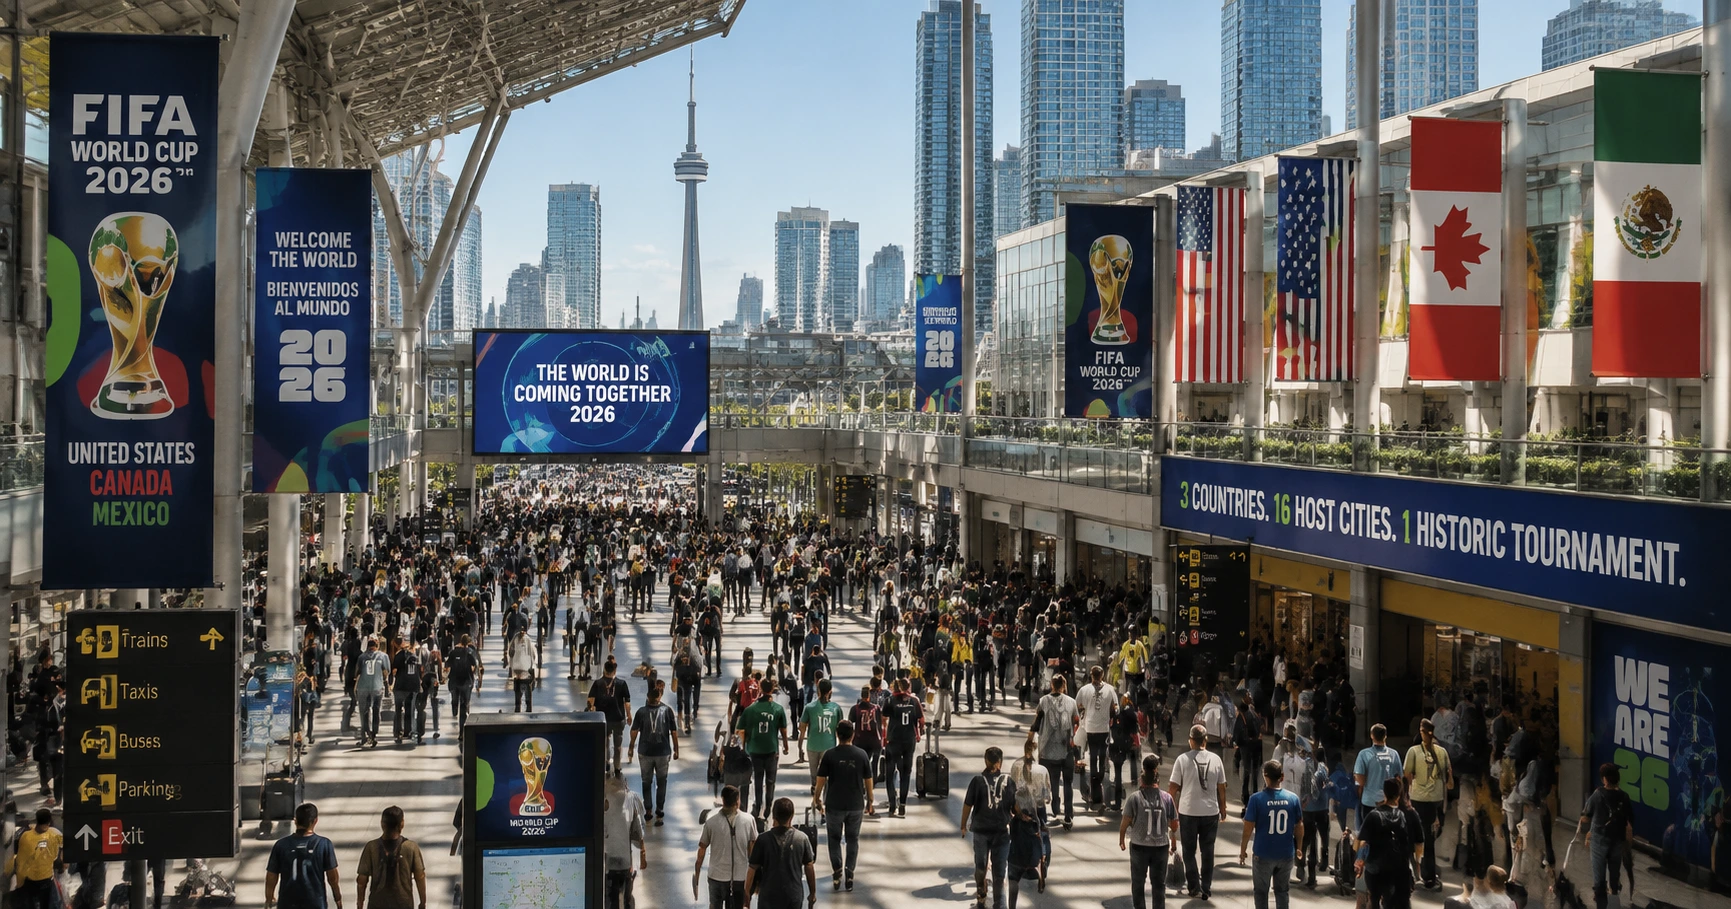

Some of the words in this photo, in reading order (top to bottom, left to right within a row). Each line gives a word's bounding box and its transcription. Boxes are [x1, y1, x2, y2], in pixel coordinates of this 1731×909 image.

[72, 93, 197, 136] FIFA
[70, 140, 150, 163] WORLD
[155, 140, 199, 163] CUP
[85, 166, 173, 195] 2026
[275, 231, 352, 249] WELCOME
[269, 250, 300, 268] THE
[303, 250, 358, 269] WORLD
[267, 281, 359, 299] BIENVENIDOS
[274, 300, 294, 316] AL
[297, 300, 351, 316] MUNDO
[279, 328, 348, 366] 20
[1095, 351, 1125, 365] FIFA
[536, 363, 567, 382] THE
[571, 363, 630, 382] WORLD
[634, 364, 649, 382] IS
[1079, 365, 1118, 378] WORLD
[1120, 365, 1141, 378] CUP
[278, 366, 348, 403] 26
[514, 384, 582, 403] COMING
[586, 384, 672, 403] TOGETHER
[1092, 378, 1124, 391] 2026
[570, 405, 616, 424] 2026
[67, 441, 130, 465] UNITED
[134, 441, 196, 465] STATES
[89, 468, 174, 497] CANADA
[92, 500, 171, 527] MEXICO
[1179, 481, 1189, 510] 3
[1191, 483, 1270, 523] COUNTRIES.
[1273, 492, 1291, 526] 16
[1294, 495, 1336, 533] HOST
[1339, 500, 1397, 543] CITIES.
[1402, 509, 1411, 544] 1
[1416, 511, 1506, 561] HISTORIC
[1511, 522, 1687, 588] TOURNAMENT.
[121, 630, 168, 649] Trains
[120, 683, 159, 700] Taxis
[1614, 654, 1670, 714] WE
[1613, 704, 1670, 759] ARE
[119, 734, 161, 750] Buses
[1613, 747, 1670, 812] 26
[1267, 809, 1289, 835] 10
[108, 826, 145, 845] Exit
